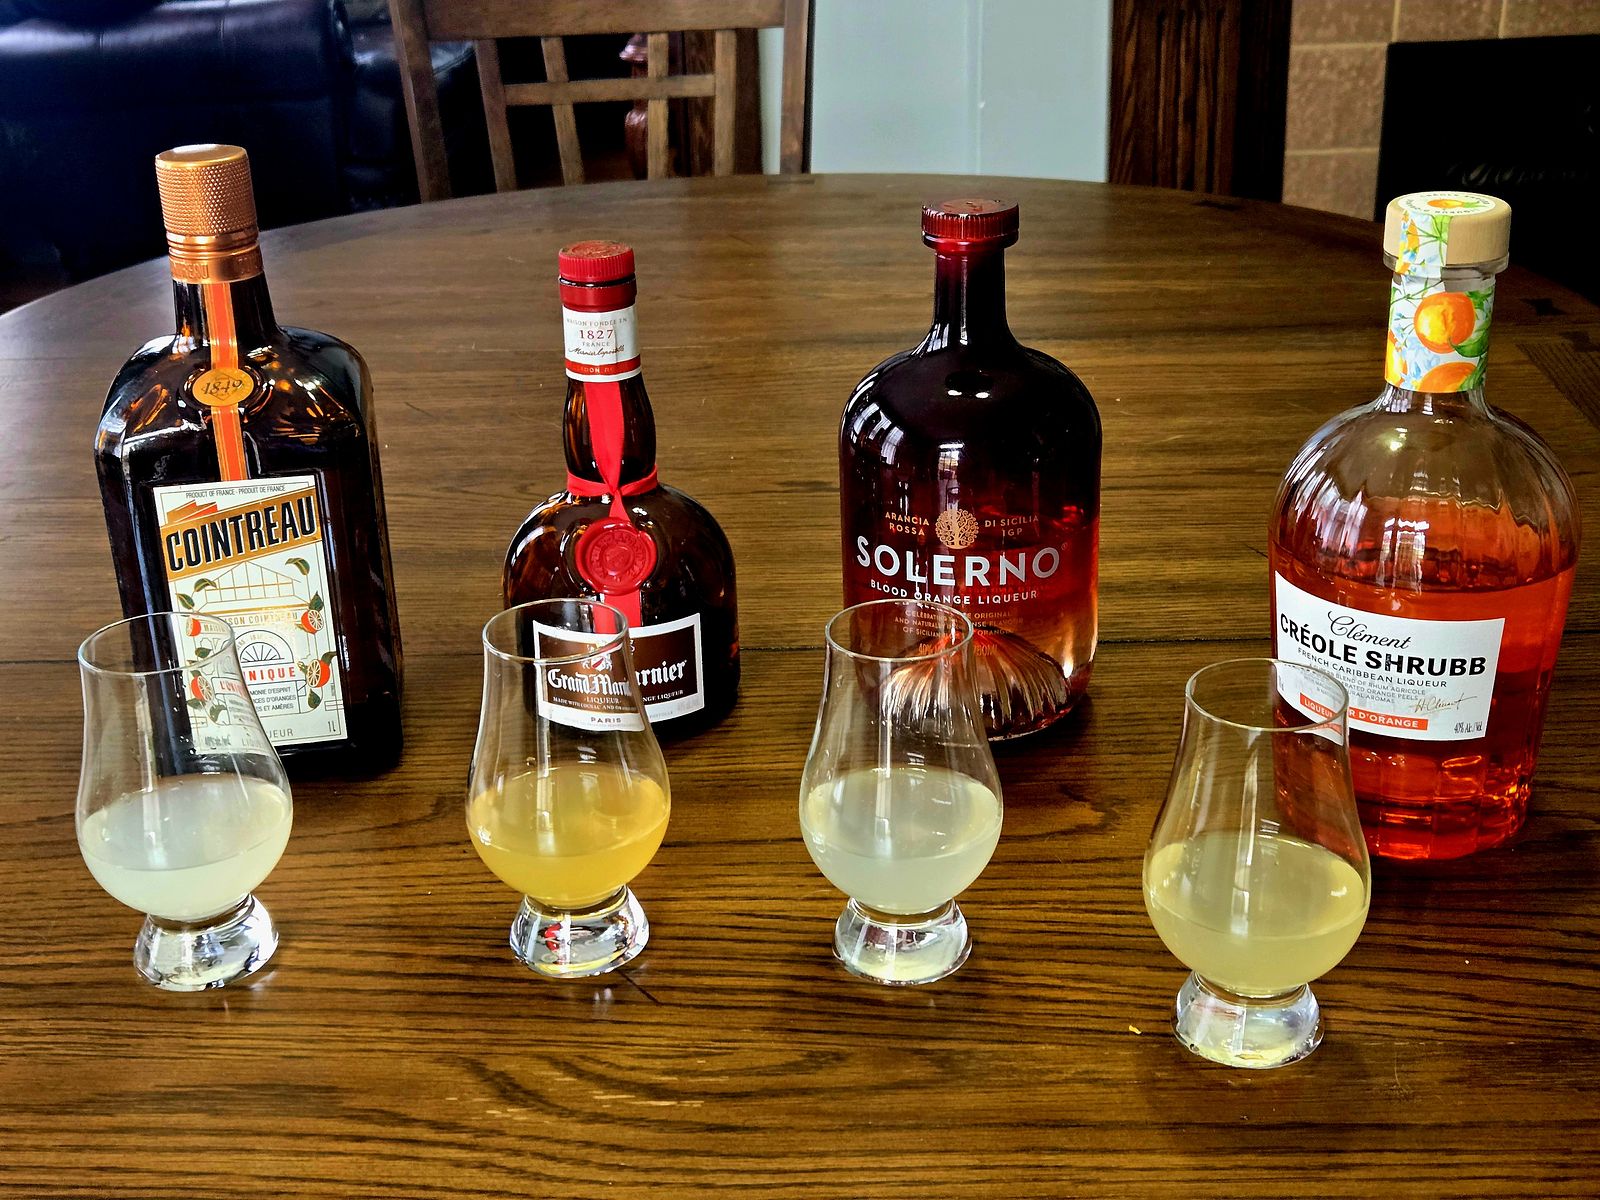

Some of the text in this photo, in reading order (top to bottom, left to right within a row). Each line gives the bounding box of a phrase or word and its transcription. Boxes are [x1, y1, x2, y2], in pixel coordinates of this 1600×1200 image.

[579, 329, 614, 340] 1827
[185, 485, 286, 499] PRODUCT OF FRANCE PRODUIT DE FRANCE
[885, 511, 930, 526] ARANCIA
[984, 515, 1040, 528] DI SICILIA
[166, 495, 317, 573] COINTREAU
[889, 522, 926, 537] ROSSA
[1002, 527, 1024, 538] IGP
[856, 535, 1060, 588] SOLERNO
[870, 579, 1038, 606] BLOOD ORANGE LIQUEUR
[248, 611, 299, 624] COINTAU
[902, 626, 914, 635] OF
[1327, 610, 1412, 650] Clément
[1280, 613, 1487, 677] CRÉOLE SHRUBB
[243, 666, 296, 682] NIQUE
[1297, 647, 1330, 668] FRENCH
[1332, 661, 1393, 684] CARIBBEAN
[1397, 677, 1448, 688] LIQUEUR
[547, 668, 591, 695] Grand
[1336, 673, 1356, 684] BLEND
[1368, 682, 1389, 692] RHUM
[1390, 686, 1427, 696] AGRICOLE
[267, 686, 291, 695] D'ESPRIT
[656, 689, 684, 699] LIQUEUR
[1366, 688, 1396, 698] ORANGE
[1397, 693, 1419, 701] PEELS
[266, 694, 297, 704] D'ORANGES
[585, 696, 620, 705] LIQUEUR
[1365, 694, 1396, 704] AROMAS
[590, 716, 622, 724] PARIS
[1358, 711, 1420, 728] D'ORANGE
